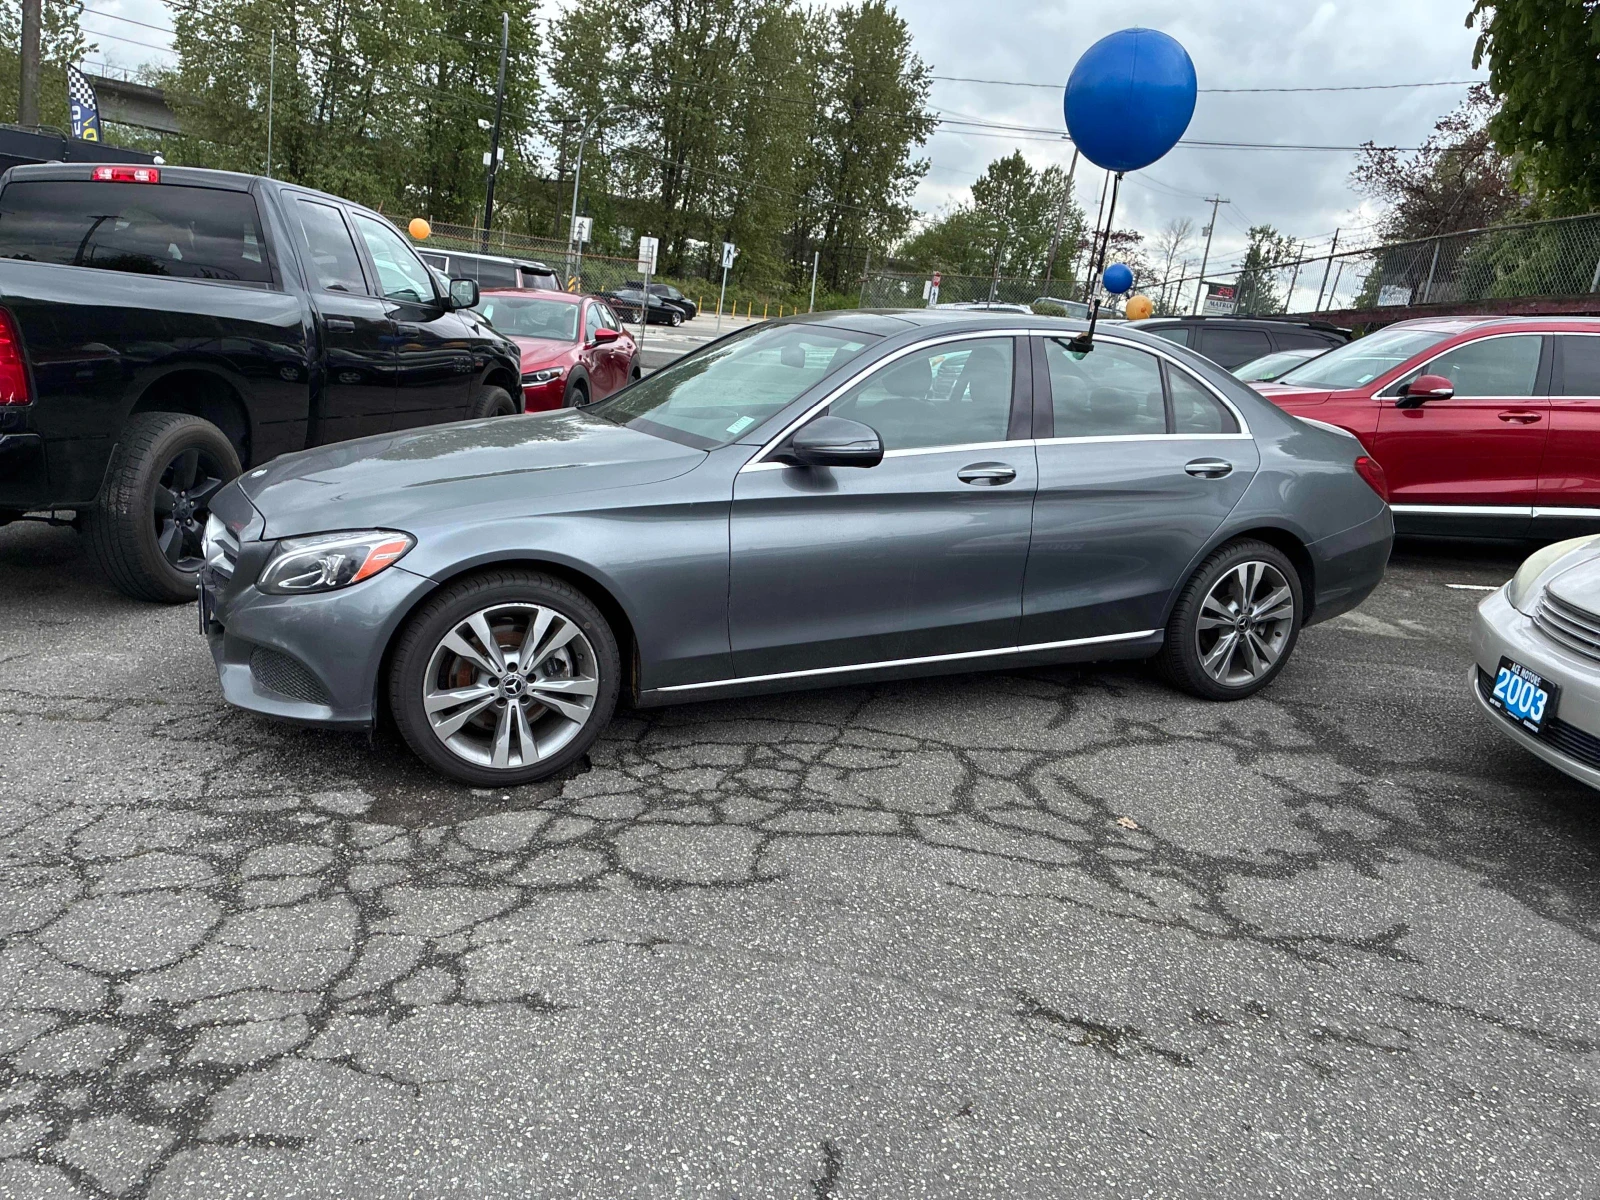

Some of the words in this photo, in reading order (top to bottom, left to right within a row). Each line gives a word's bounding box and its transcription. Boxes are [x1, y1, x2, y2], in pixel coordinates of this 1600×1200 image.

[1209, 301, 1232, 309] MATRIX
[1510, 663, 1521, 675] ACE
[1520, 667, 1541, 686] MOTORS
[1493, 666, 1548, 721] 2003
